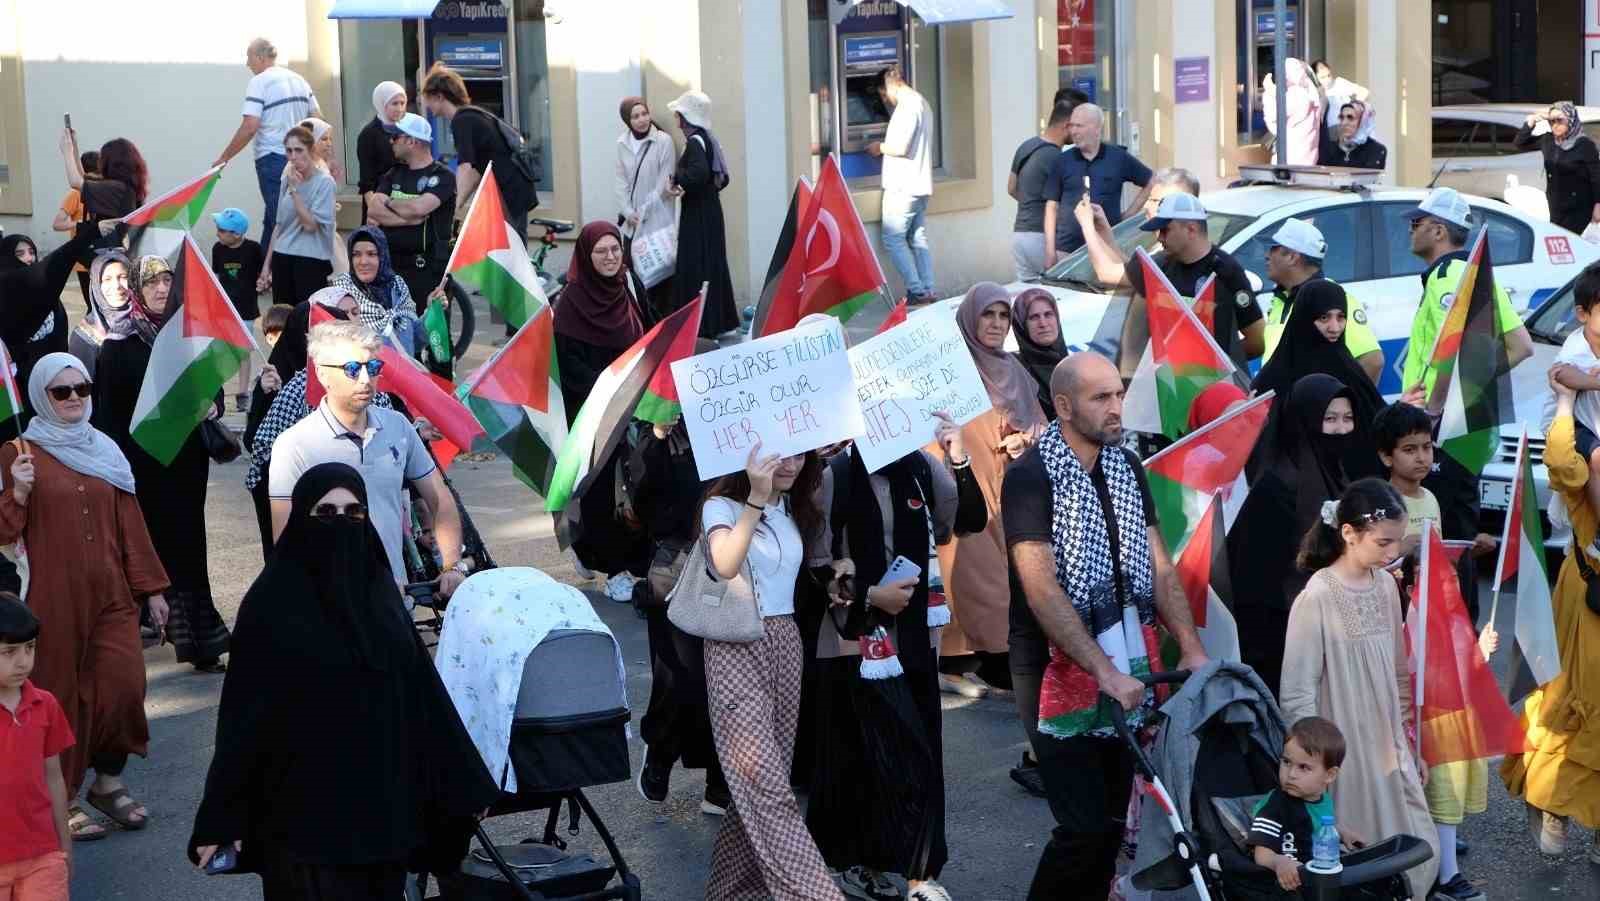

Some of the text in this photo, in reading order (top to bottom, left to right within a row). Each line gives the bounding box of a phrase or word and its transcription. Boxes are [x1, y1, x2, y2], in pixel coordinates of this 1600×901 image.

[1549, 239, 1569, 254] 112
[691, 328, 841, 395] ÖZGÜRSE FİLİSTİN
[701, 374, 821, 423] ÖZGÜR OLUR
[712, 400, 822, 454] HER YER
